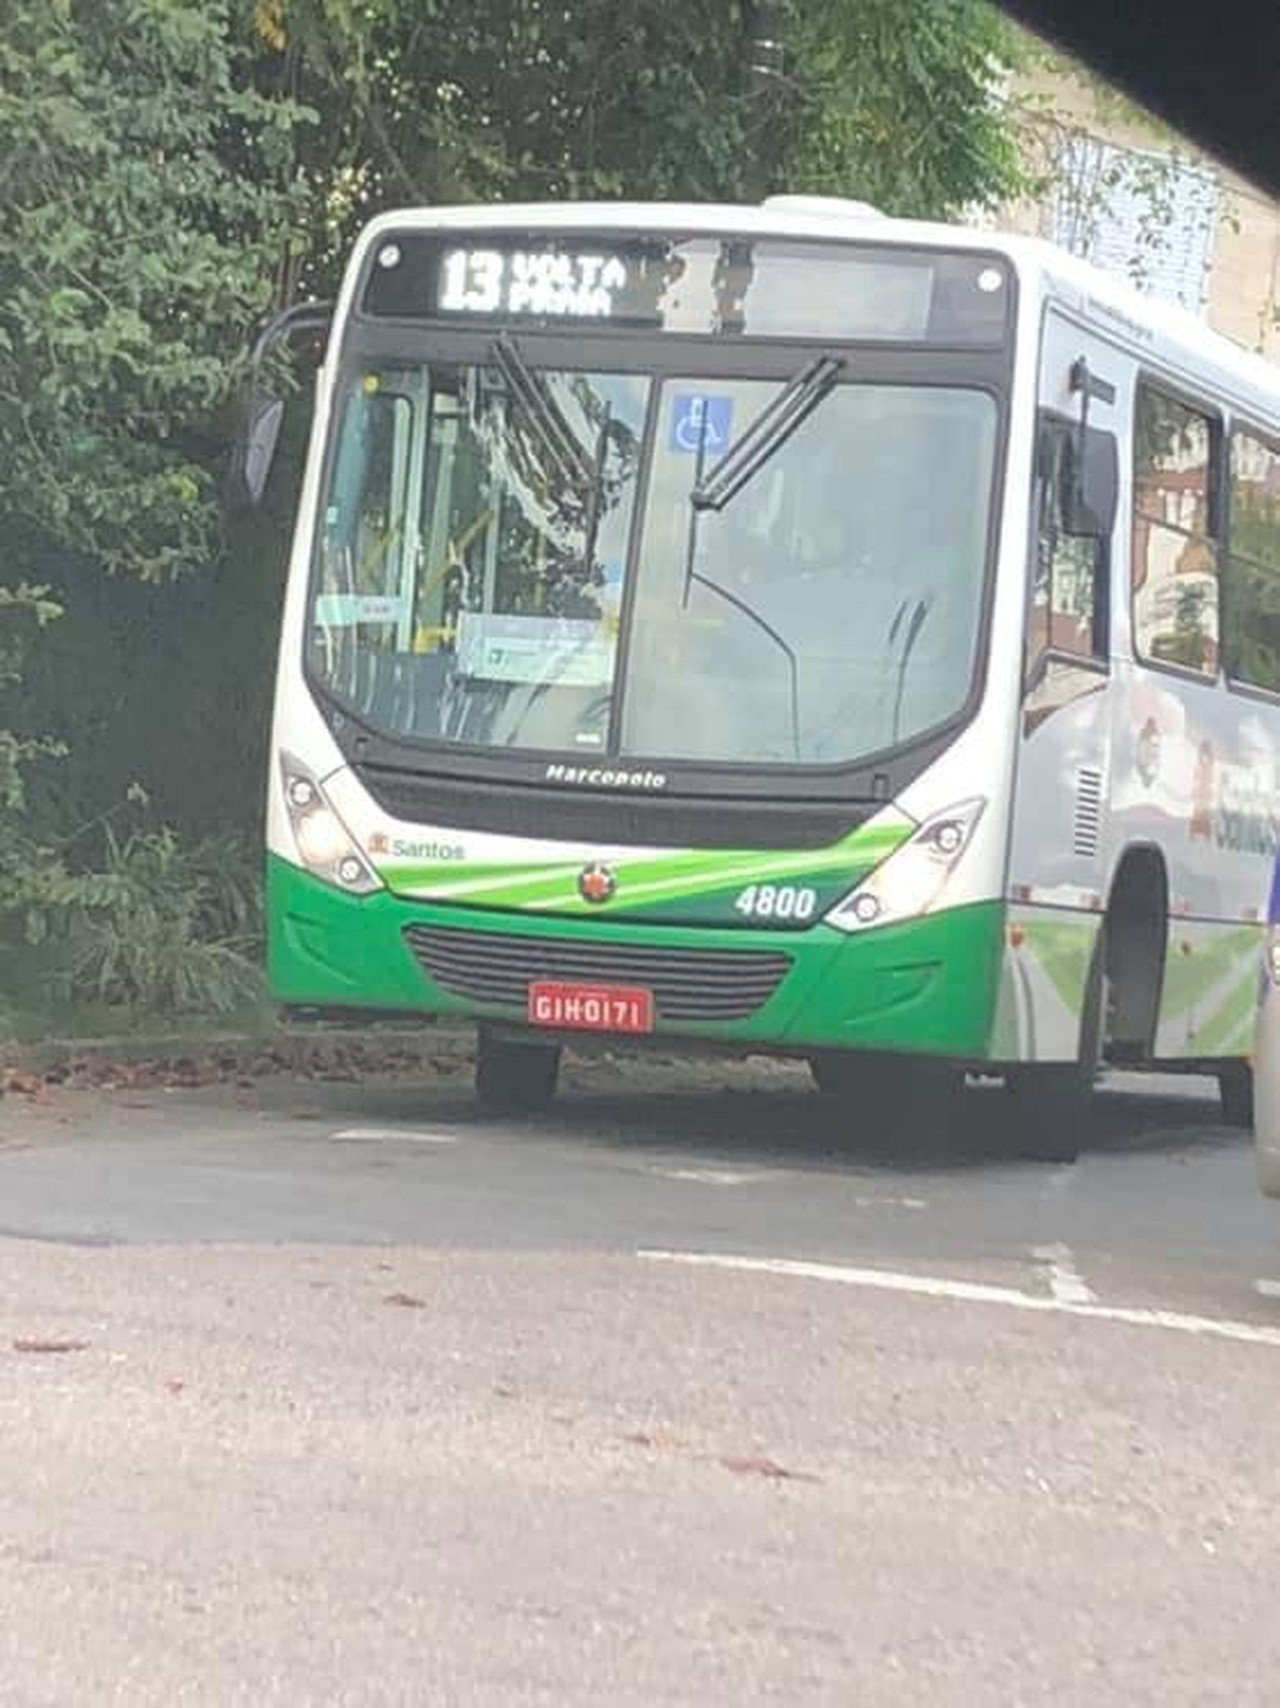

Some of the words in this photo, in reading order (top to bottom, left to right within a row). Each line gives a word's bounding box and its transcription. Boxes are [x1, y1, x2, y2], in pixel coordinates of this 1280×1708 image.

[440, 250, 504, 311] 13
[512, 252, 627, 289] VOLTA
[545, 763, 667, 789] Marcopolo
[392, 839, 466, 861] Santos
[735, 885, 817, 920] 4800
